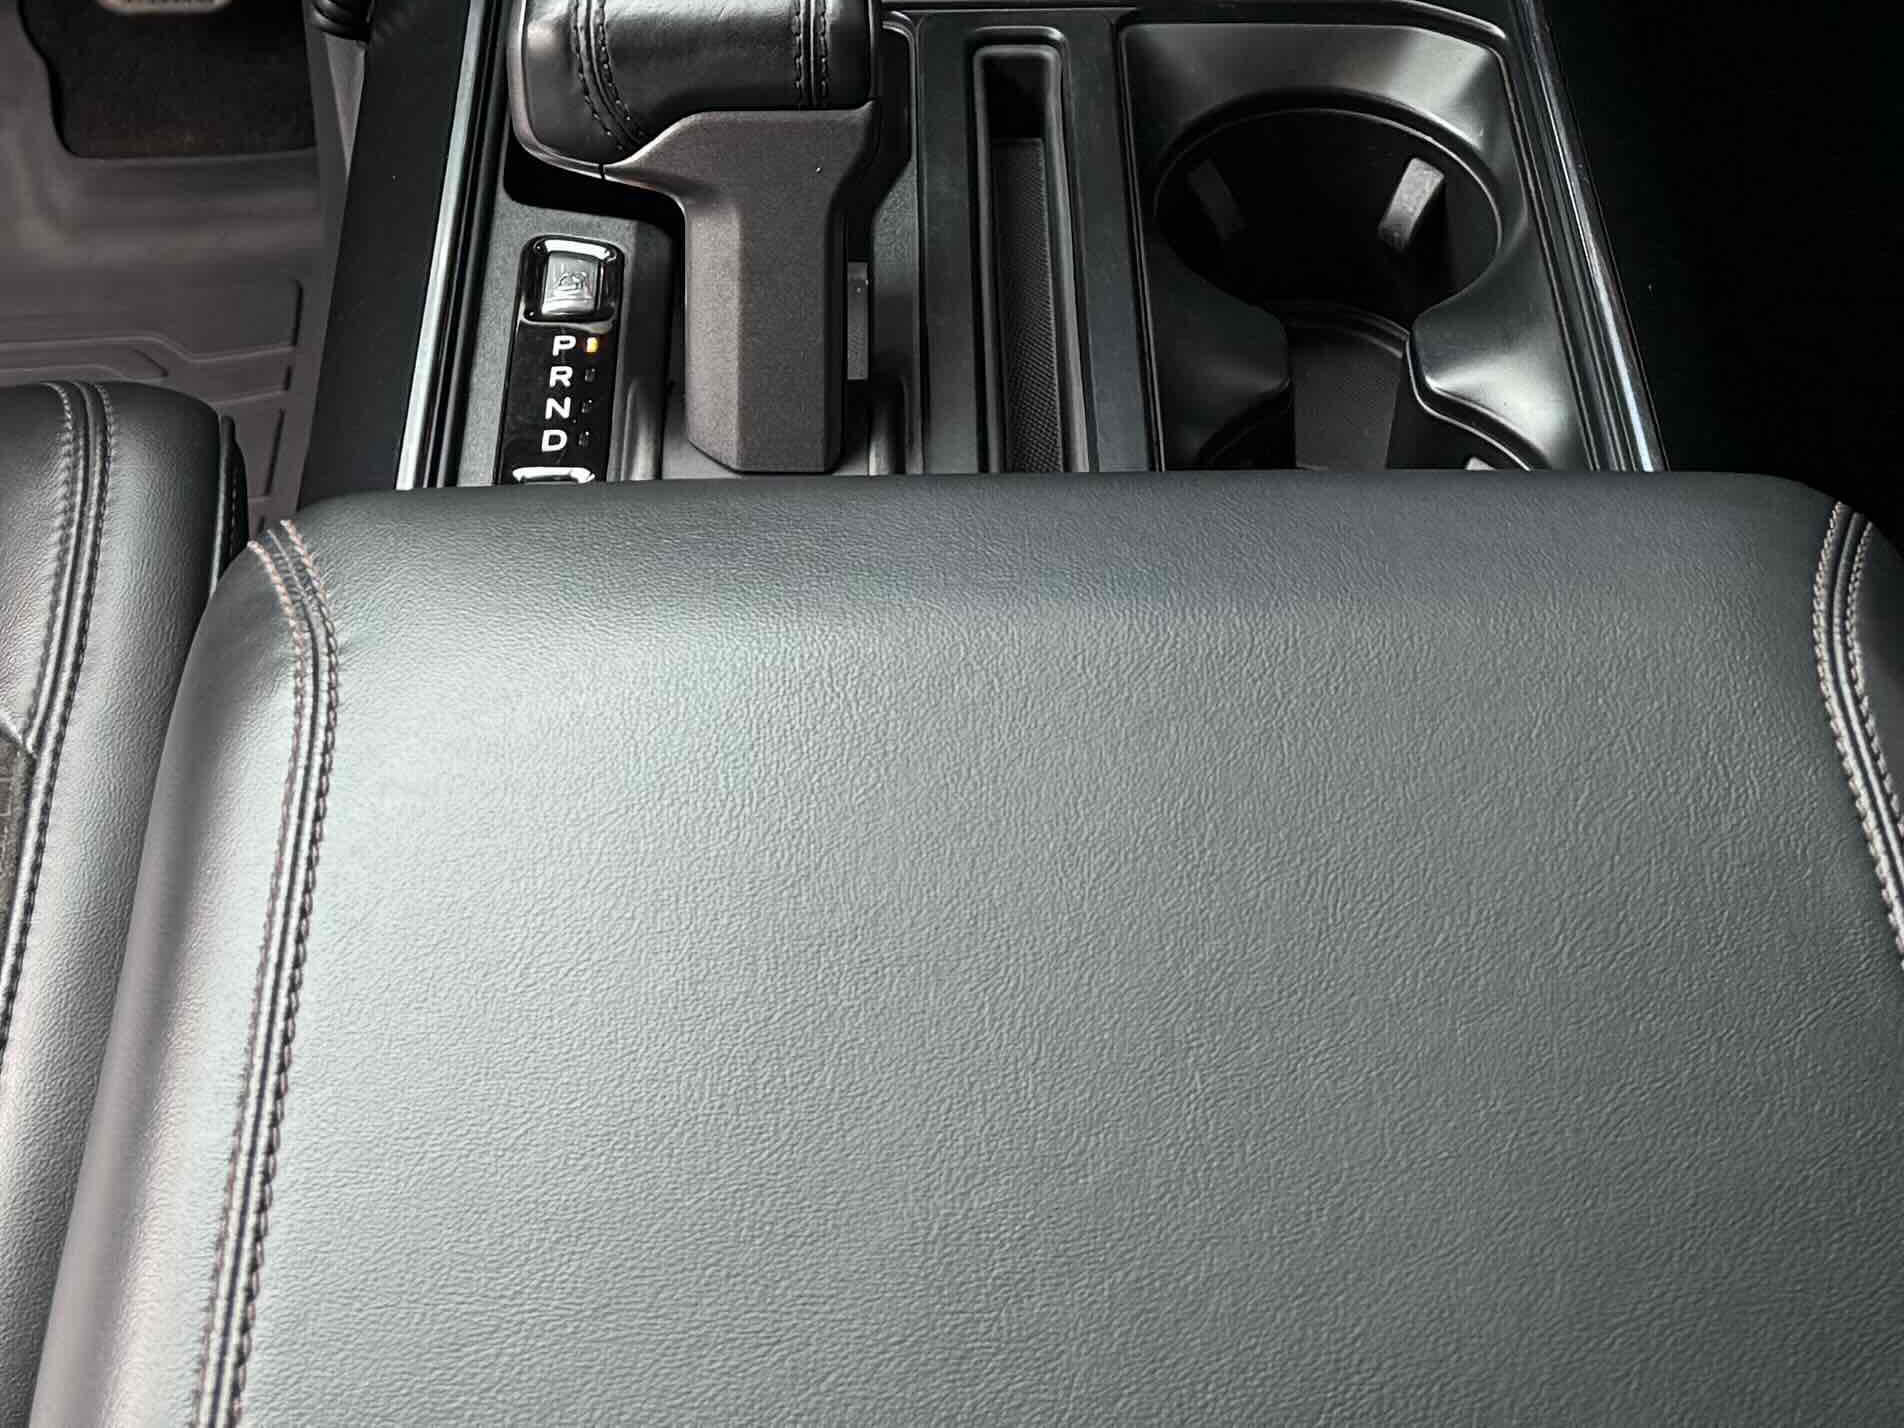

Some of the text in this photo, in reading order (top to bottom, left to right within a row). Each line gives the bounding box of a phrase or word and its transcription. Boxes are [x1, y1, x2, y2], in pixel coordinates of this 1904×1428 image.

[552, 335, 577, 356] P
[549, 366, 573, 388] R
[545, 396, 571, 420] N
[541, 429, 568, 452] D
